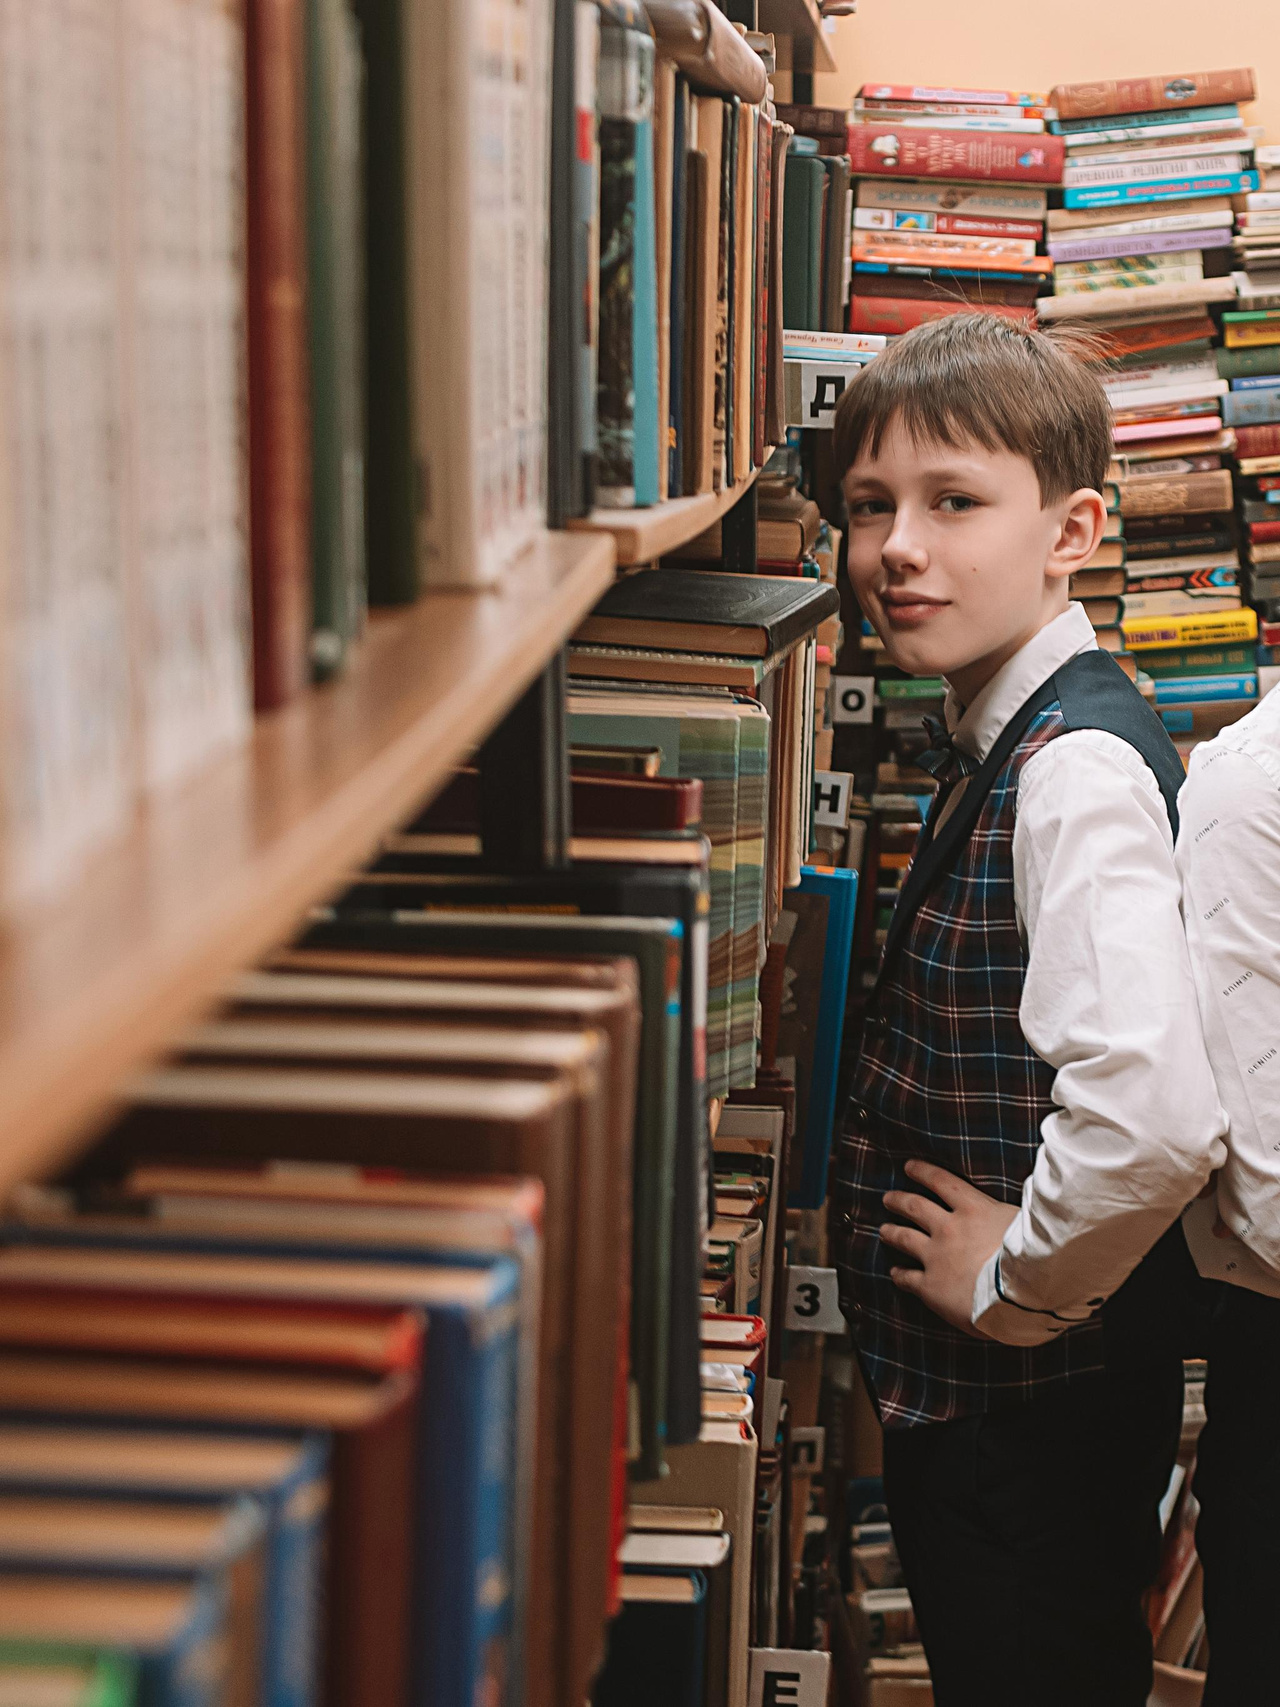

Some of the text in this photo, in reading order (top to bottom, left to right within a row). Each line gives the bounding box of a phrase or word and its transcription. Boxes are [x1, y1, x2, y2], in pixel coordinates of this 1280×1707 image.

[810, 376, 846, 418] Д
[1194, 818, 1219, 843] GENIUS
[1203, 897, 1230, 920] GENIUS
[1223, 969, 1254, 997] GENIUS
[1247, 1047, 1278, 1075] GENIUS
